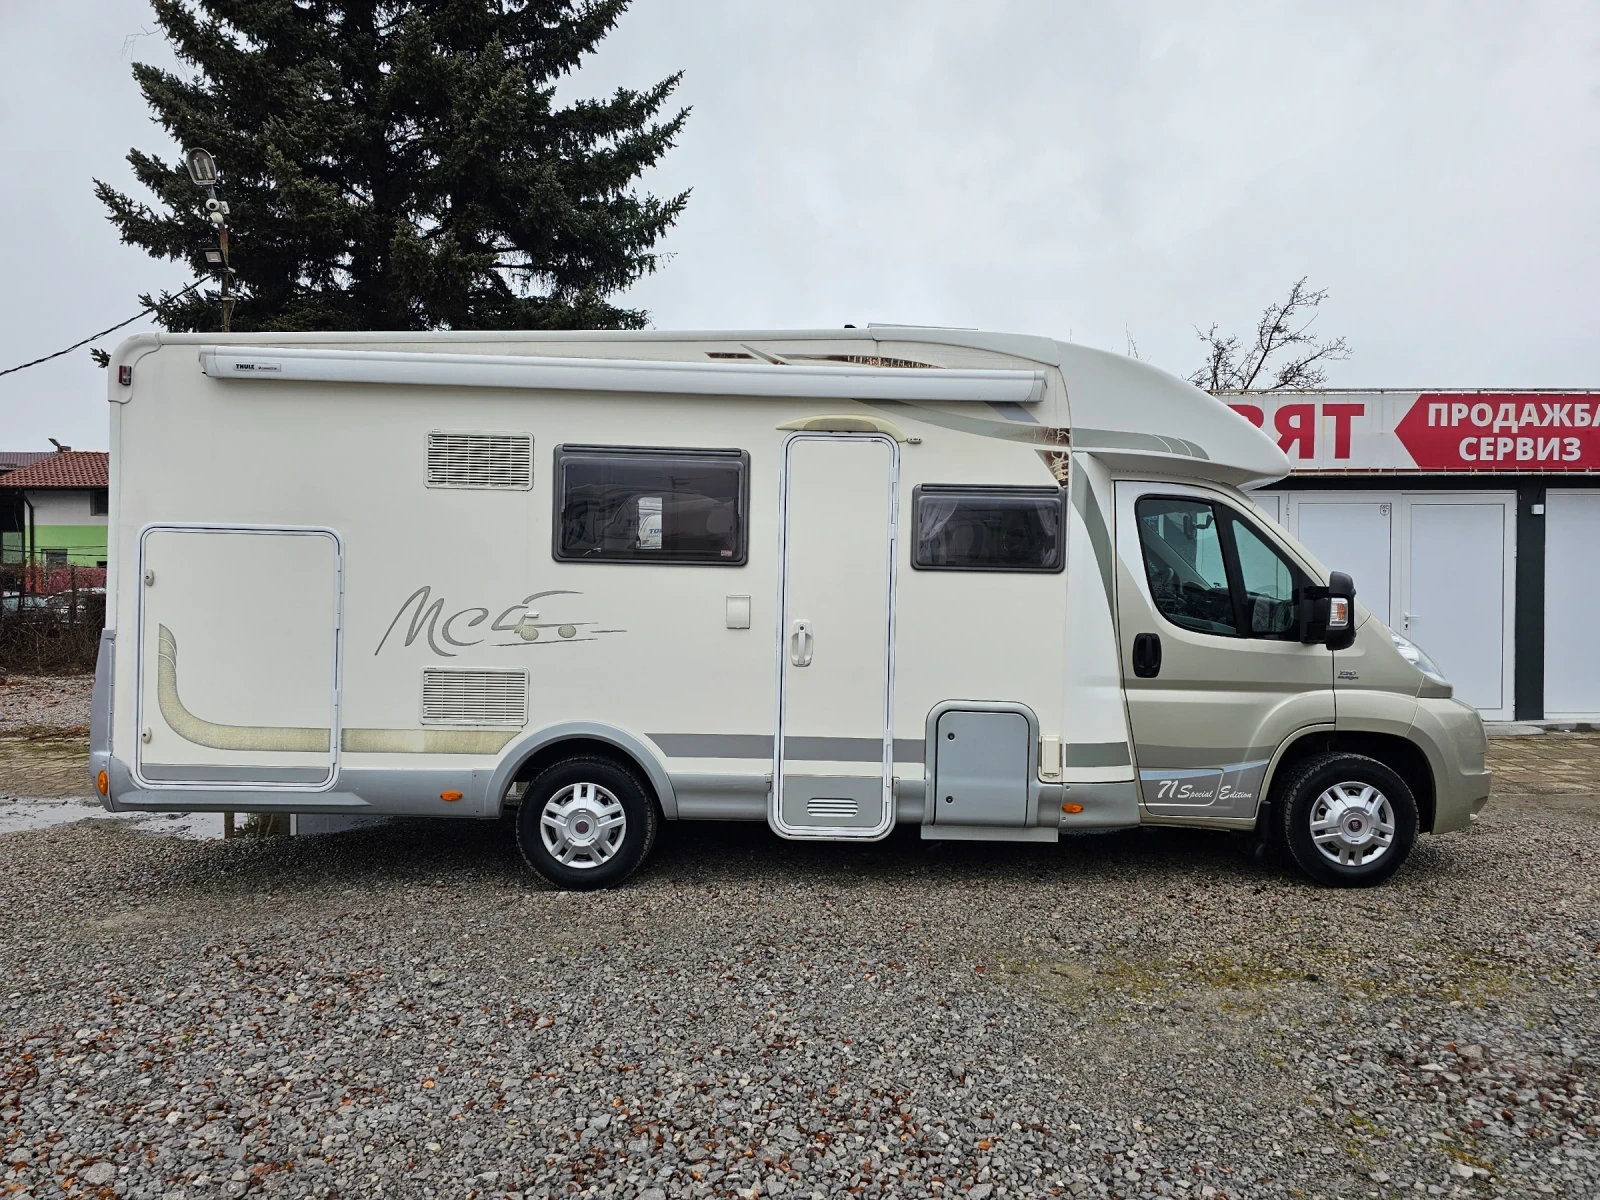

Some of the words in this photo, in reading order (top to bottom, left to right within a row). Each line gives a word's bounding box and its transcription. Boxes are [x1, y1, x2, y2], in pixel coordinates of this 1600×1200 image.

[1458, 437, 1581, 461] СЕРВИЗ
[1157, 780, 1179, 798] 71
[1177, 784, 1214, 799] Special
[1219, 785, 1252, 800] Edition
